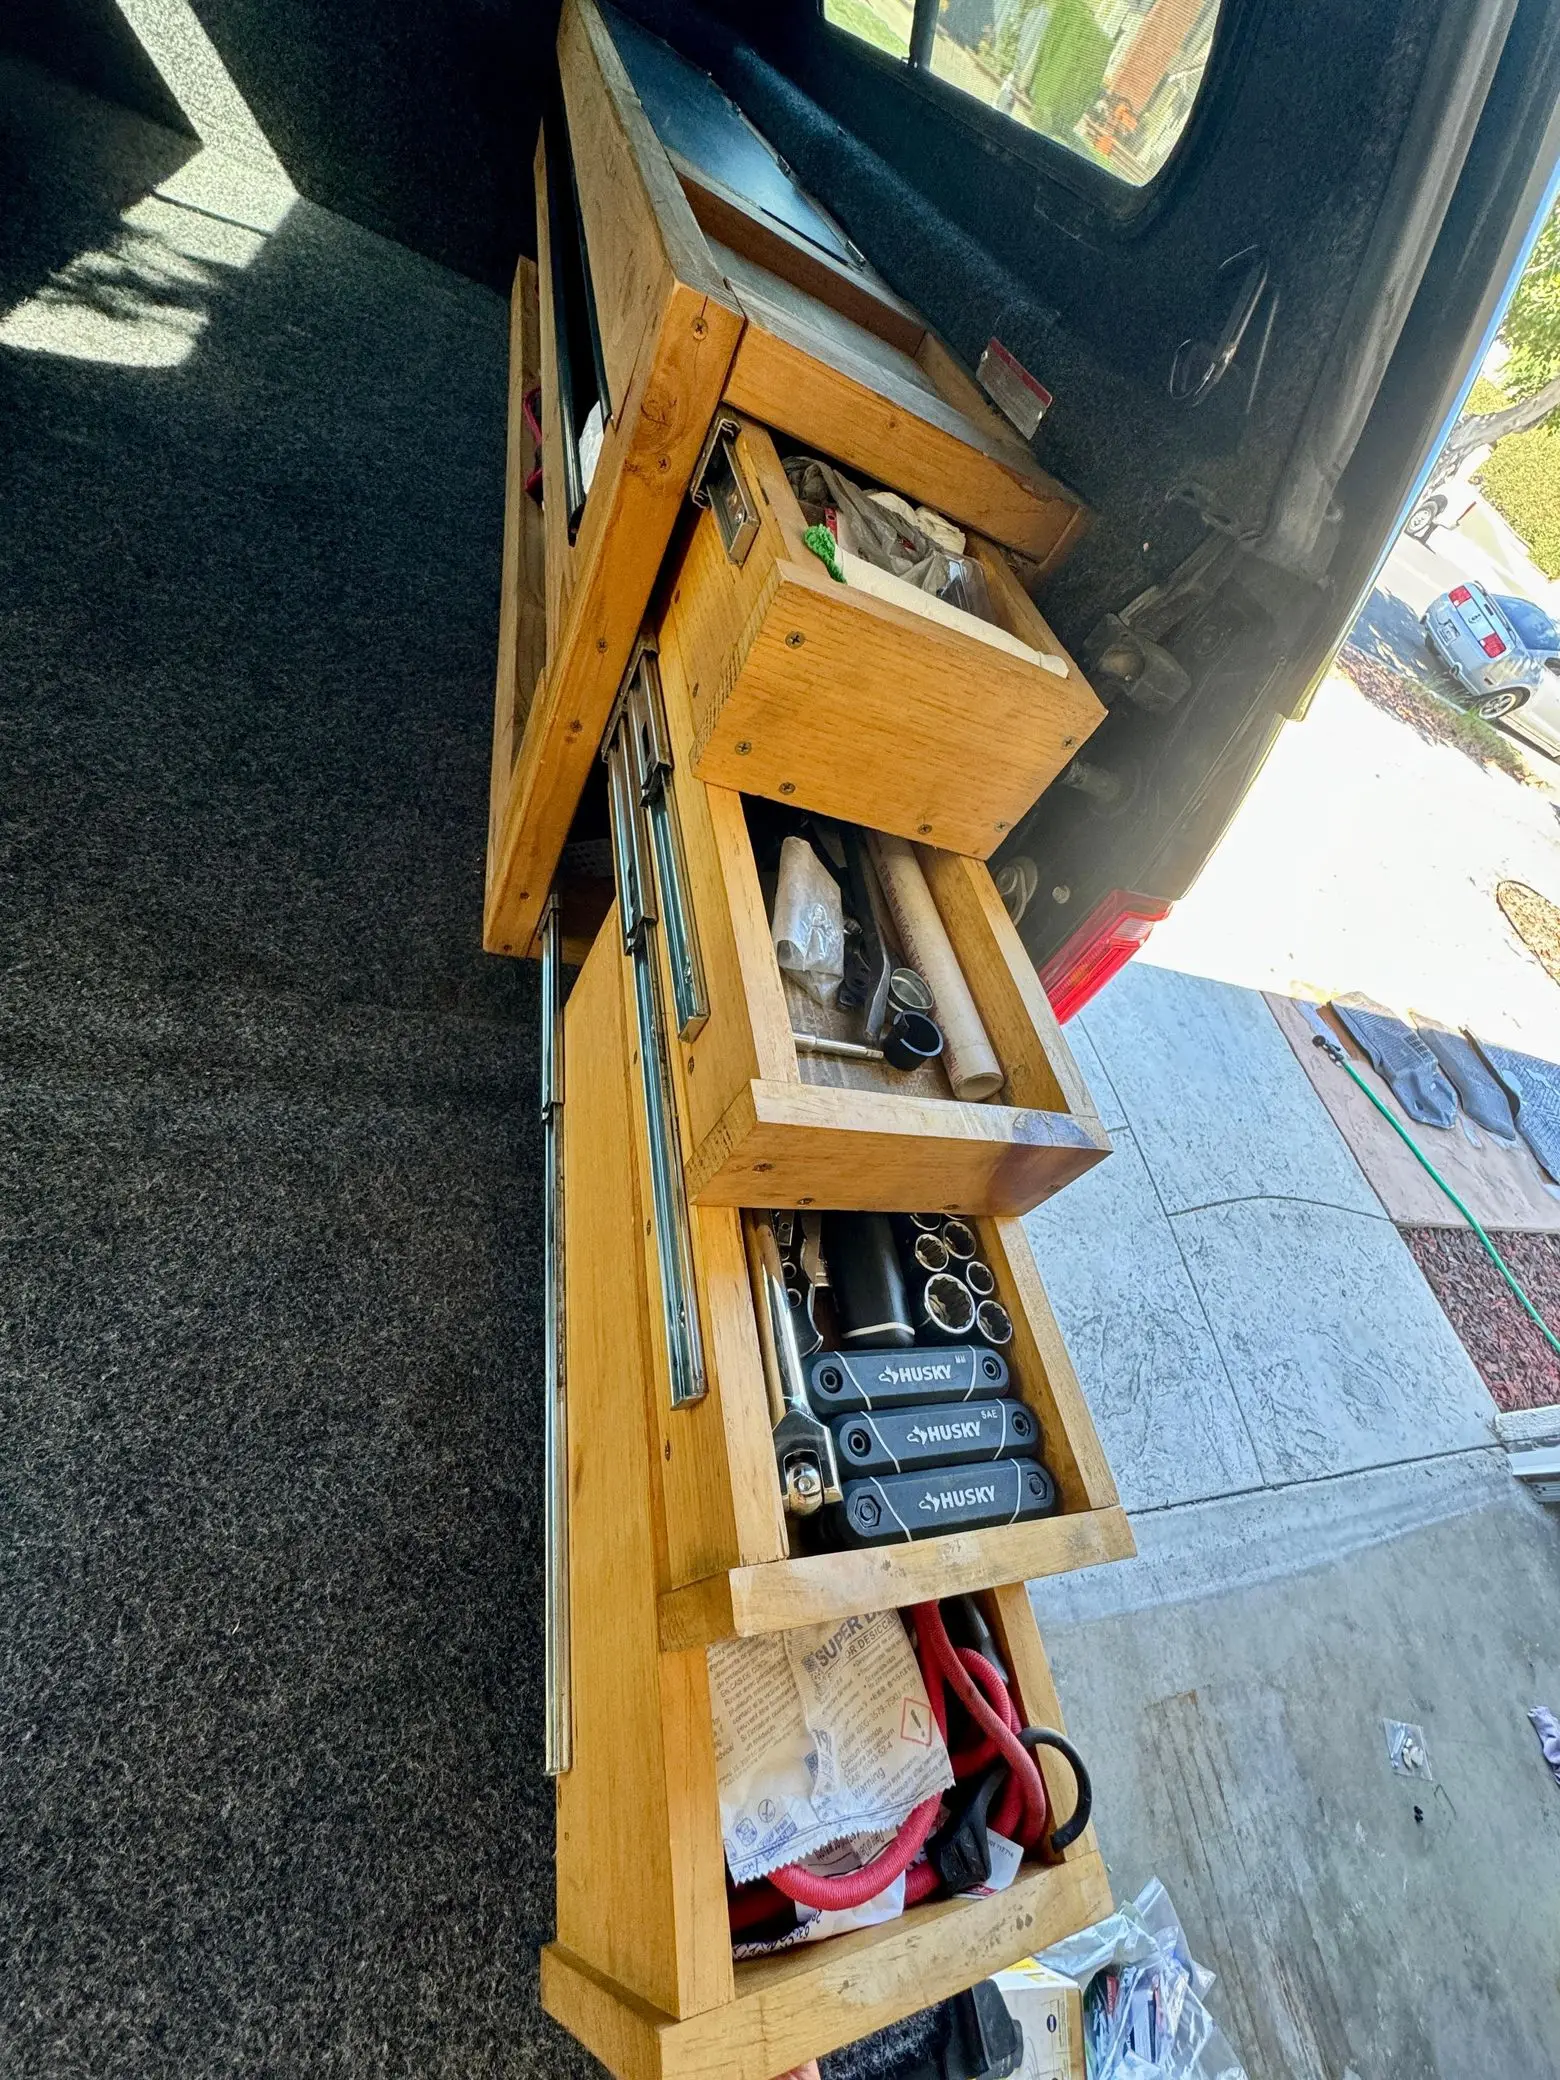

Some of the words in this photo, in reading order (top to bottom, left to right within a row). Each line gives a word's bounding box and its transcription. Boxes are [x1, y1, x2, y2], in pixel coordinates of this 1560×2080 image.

[899, 1365, 951, 1383] HUSKY
[981, 1410, 998, 1419] SAE
[926, 1421, 981, 1442] HUSKY
[939, 1485, 995, 1510] HUSKY
[815, 1615, 864, 1667] SUPER
[858, 1610, 898, 1649] DESICCAN
[852, 1767, 886, 1800] Warning
